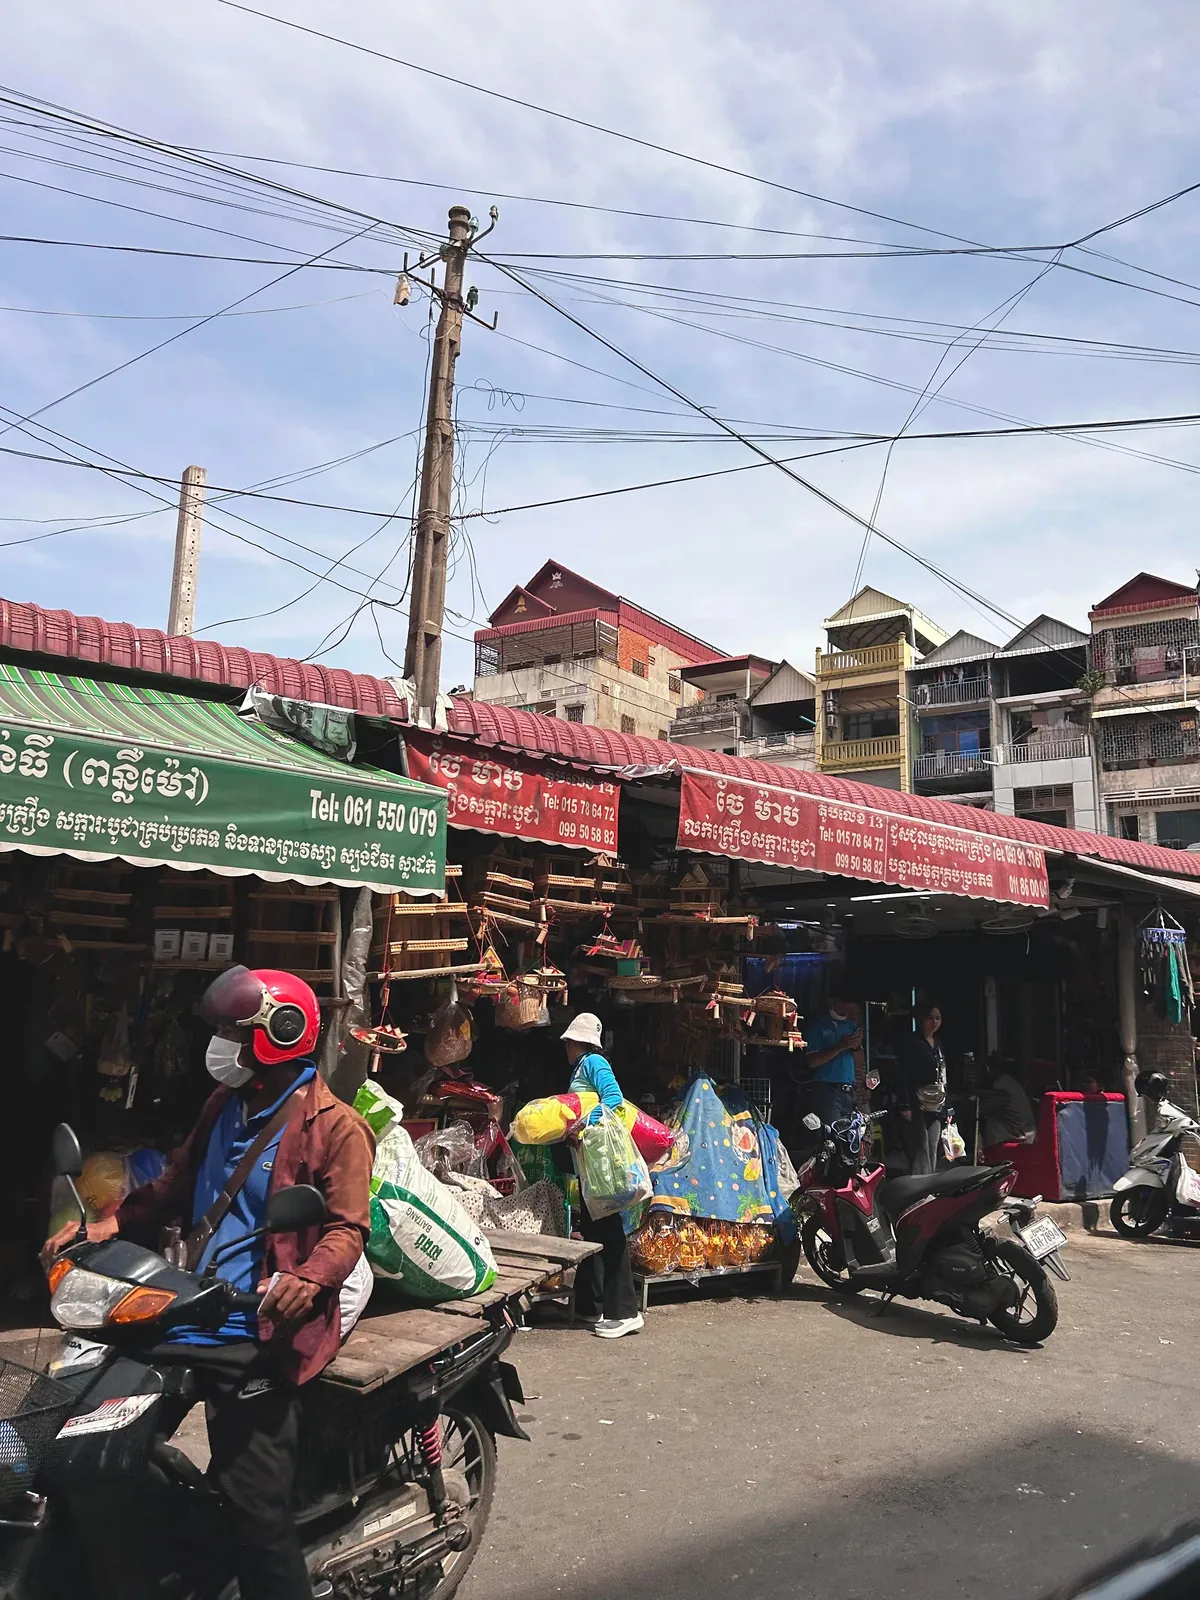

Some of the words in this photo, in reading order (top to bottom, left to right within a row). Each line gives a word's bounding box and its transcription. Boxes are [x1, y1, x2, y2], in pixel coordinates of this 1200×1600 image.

[598, 781, 615, 796] 14
[310, 789, 339, 822] Tel:
[344, 795, 372, 827] 061
[377, 801, 405, 832] 550
[409, 807, 438, 837] 079
[543, 793, 559, 810] Tel:
[562, 797, 577, 813] 015
[581, 800, 590, 816] 78
[592, 804, 602, 819] 64
[604, 806, 614, 821] 72
[559, 821, 576, 837] 099
[579, 824, 589, 839] 50
[591, 827, 601, 842] 58
[604, 829, 614, 845] 82
[869, 816, 884, 829] 13
[819, 826, 834, 843] Tel:
[836, 829, 850, 845] 015
[851, 832, 861, 848] 78
[863, 835, 872, 850] 64
[875, 837, 884, 852] 72
[835, 852, 849, 868] 099
[850, 855, 860, 871] 50
[862, 858, 872, 873] 58
[873, 860, 883, 875] 82
[405, 1207, 432, 1233] BAITANG
